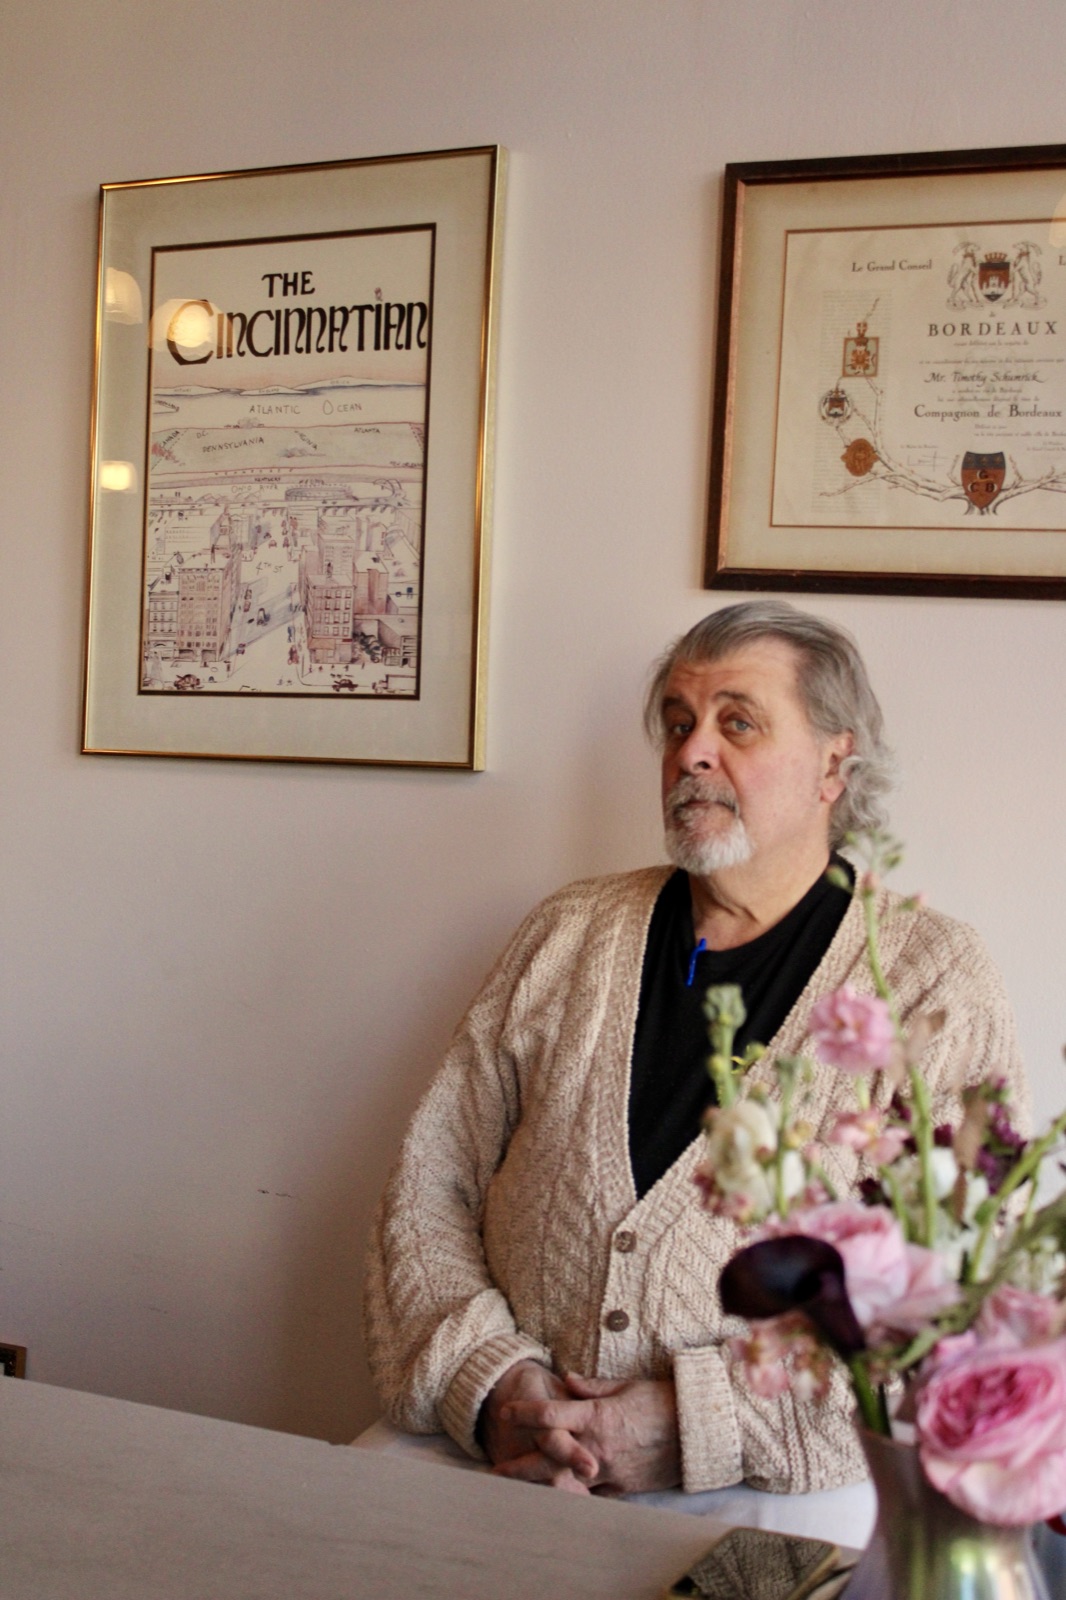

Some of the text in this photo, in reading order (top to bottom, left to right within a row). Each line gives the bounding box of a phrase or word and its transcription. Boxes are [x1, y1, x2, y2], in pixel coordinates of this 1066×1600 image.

[851, 258, 932, 272] Le Grand Conseil
[261, 270, 316, 298] THE
[928, 321, 1058, 337] BORDEAUX
[924, 371, 946, 383] Mr.
[952, 370, 987, 387] Timothy
[249, 399, 362, 415] ATLANTIC OCEAN
[914, 404, 1062, 422] Compagnon de Bordeaux
[202, 436, 265, 453] PENNSYLVANIA
